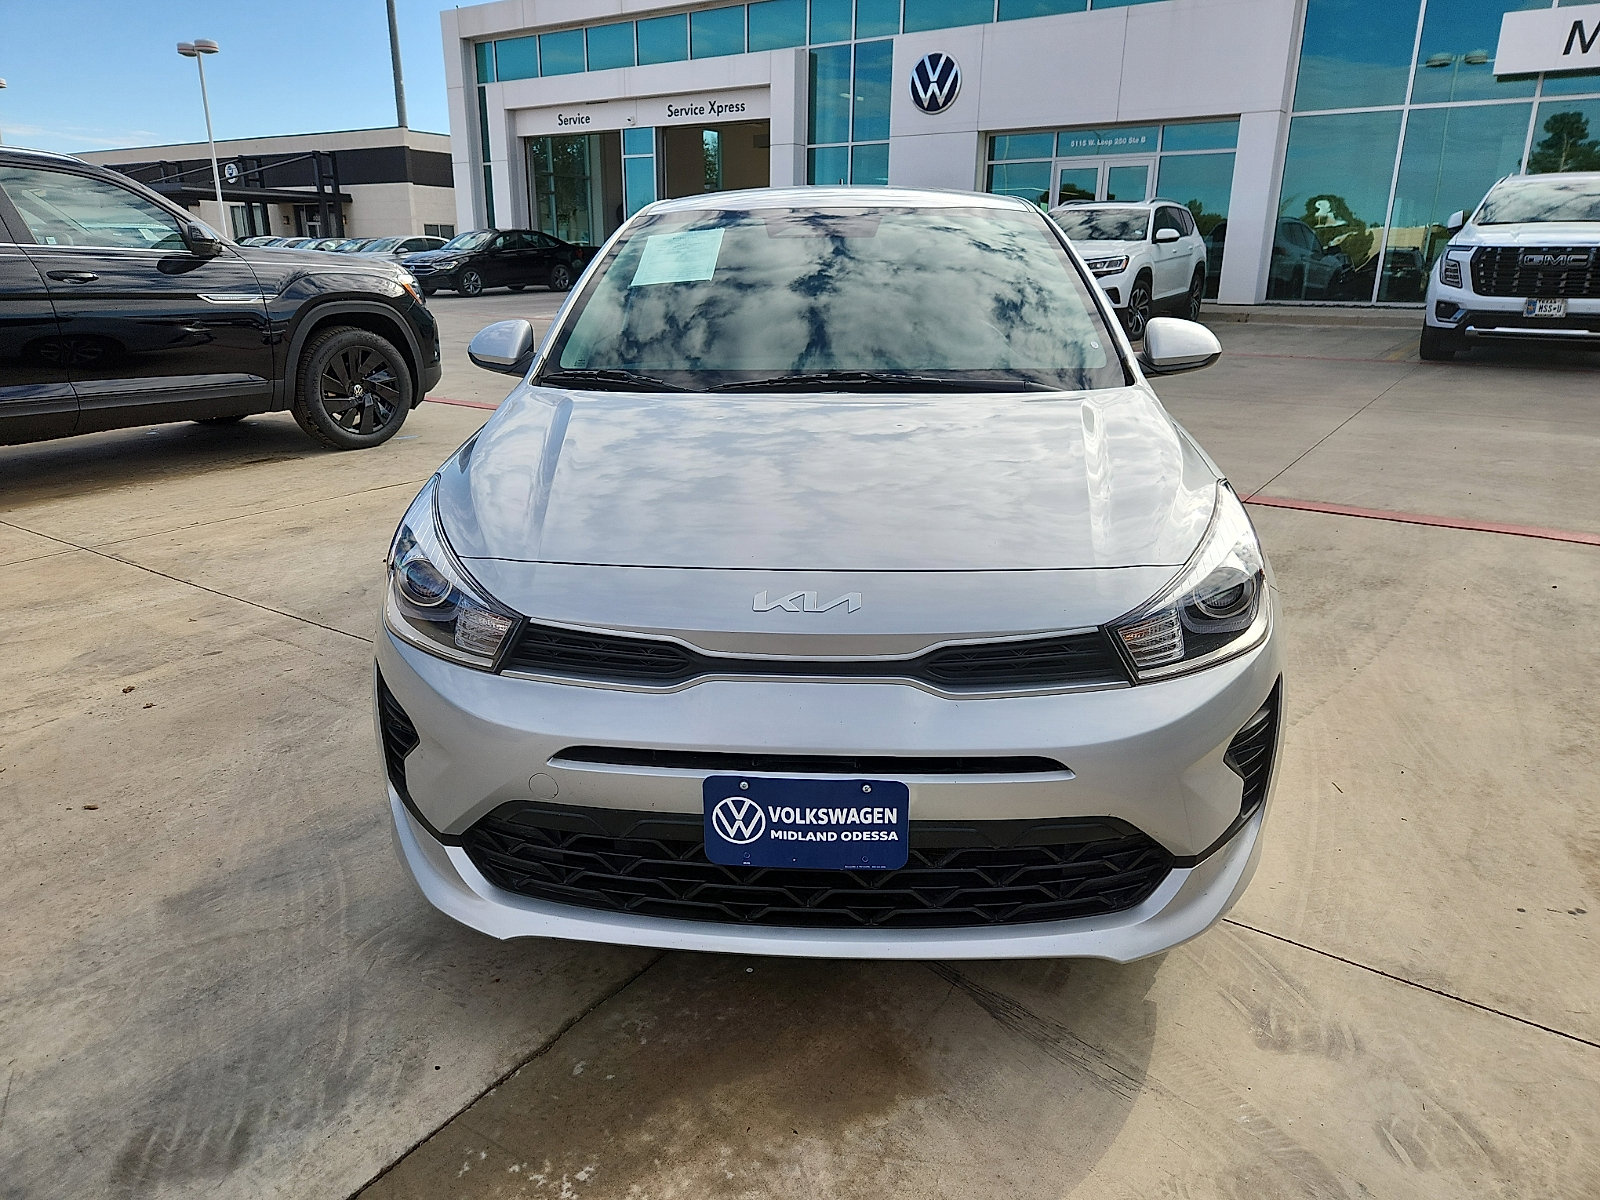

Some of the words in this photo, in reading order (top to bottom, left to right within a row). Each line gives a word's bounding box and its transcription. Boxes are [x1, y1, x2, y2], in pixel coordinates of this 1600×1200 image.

[667, 104, 705, 118] Service
[708, 100, 746, 116] Xpress
[558, 113, 591, 126] Service
[1524, 254, 1589, 266] GMC
[752, 590, 862, 613] KIA
[768, 805, 898, 825] VOLKSWAGEN
[770, 829, 838, 842] MIDLAND
[840, 831, 899, 842] ODESSA
